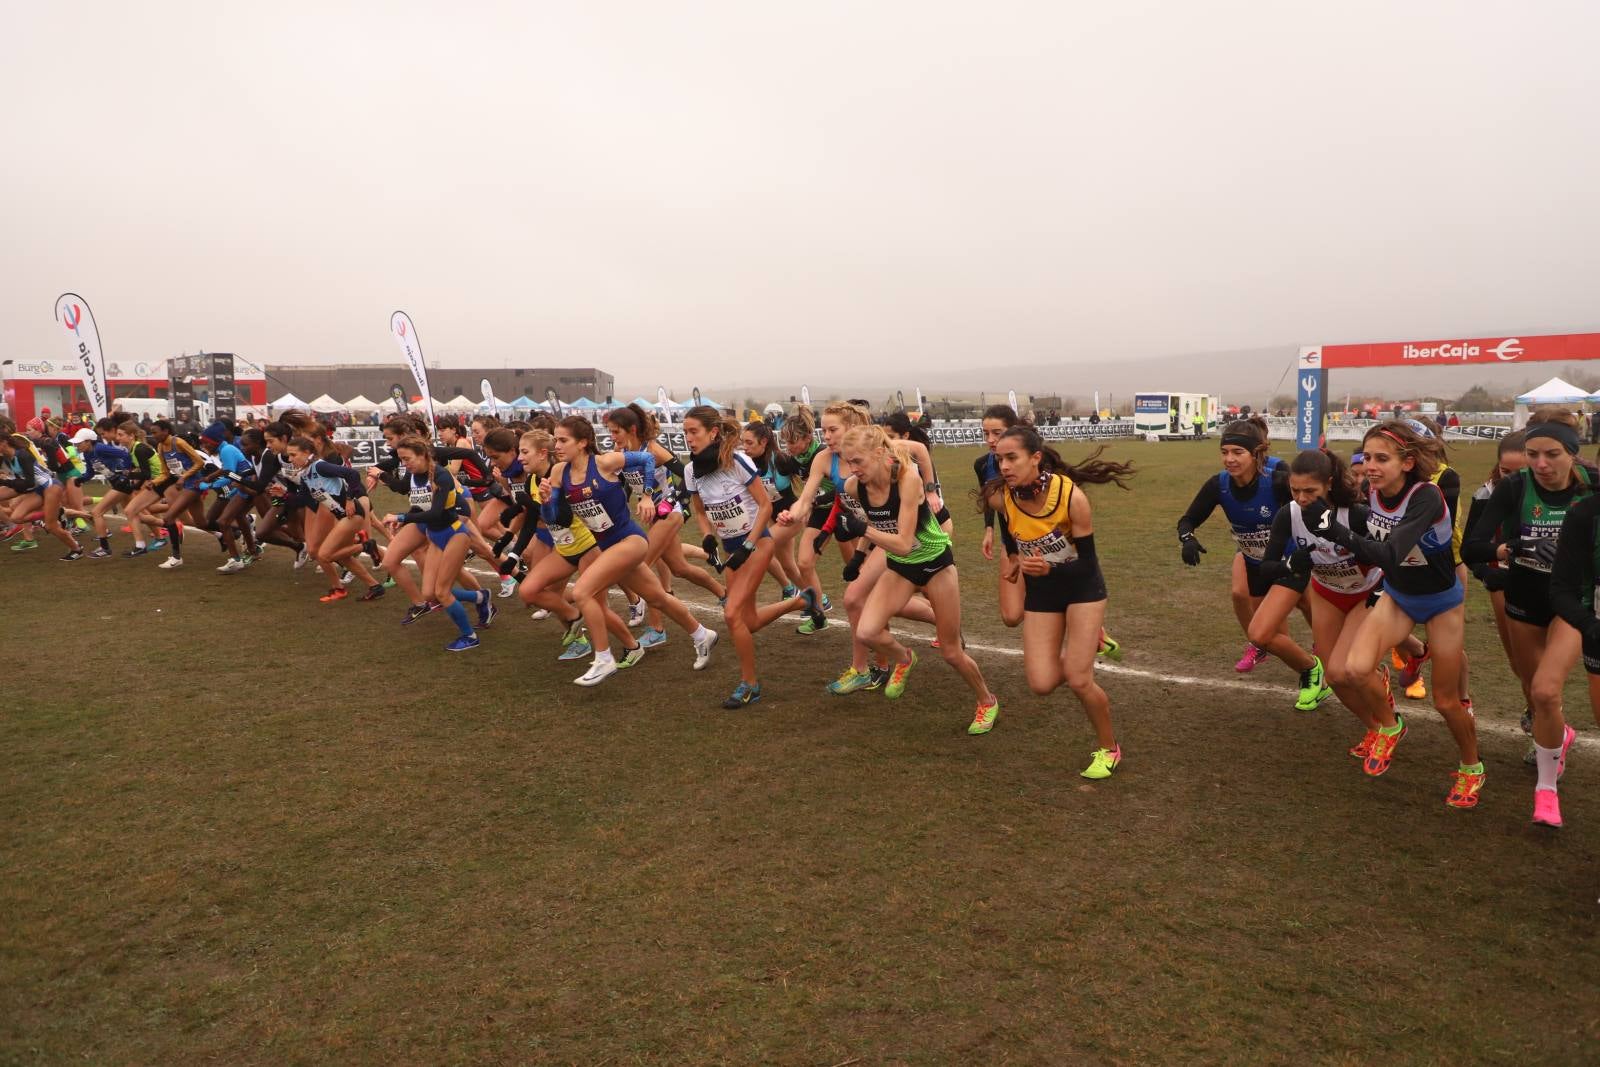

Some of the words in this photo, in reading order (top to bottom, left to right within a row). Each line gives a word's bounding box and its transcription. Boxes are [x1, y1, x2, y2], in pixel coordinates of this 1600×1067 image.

[1403, 343, 1480, 360] iberCaja
[1302, 400, 1315, 444] iberCaja
[711, 505, 744, 521] ZABALETA
